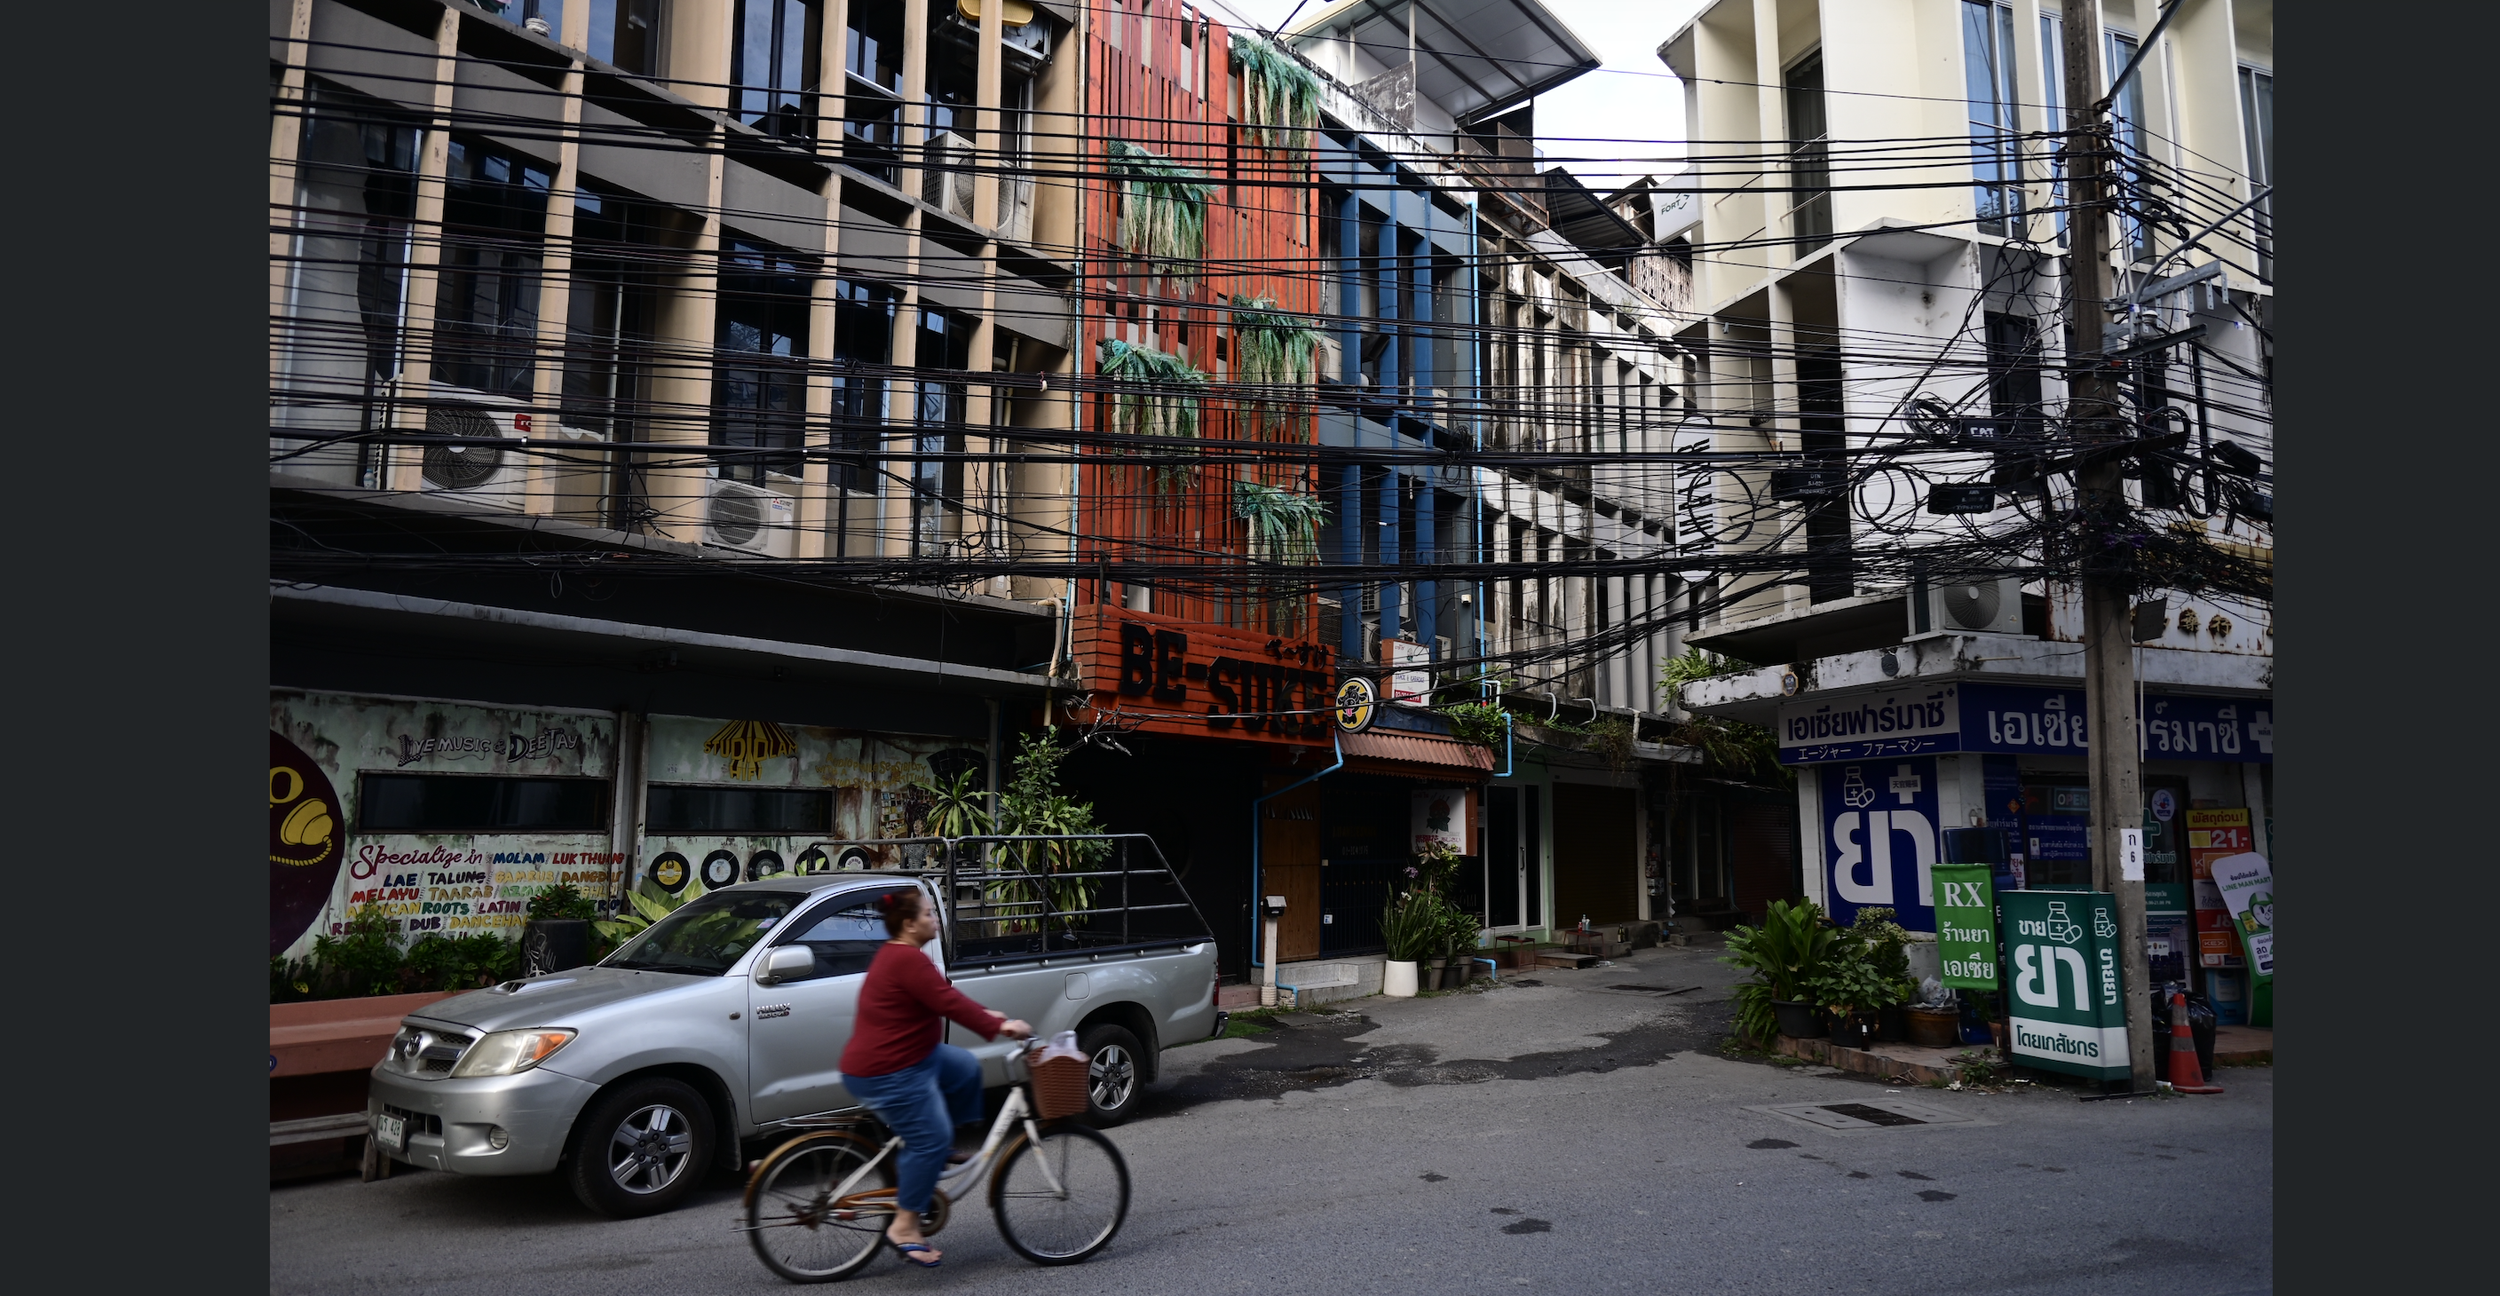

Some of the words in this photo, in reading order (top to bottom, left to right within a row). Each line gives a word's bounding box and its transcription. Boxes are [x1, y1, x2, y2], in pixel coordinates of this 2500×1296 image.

[1661, 199, 1681, 215] FORT
[1119, 622, 1328, 739] BE-SUKE
[1986, 694, 2241, 755] เอเซียาร์มาซี
[437, 737, 491, 753] MUSIC
[1797, 743, 1851, 761] エージャー
[1862, 737, 1936, 757] ファーマシー
[2057, 792, 2088, 806] OPEN
[2192, 811, 2243, 826] พัสดุด่วน!
[2128, 834, 2136, 846] ก
[351, 845, 463, 880] Specialize
[464, 851, 483, 864] in
[492, 852, 545, 864] MOLAM
[552, 853, 578, 864] LUK
[1832, 809, 1937, 907] ยา
[2130, 851, 2136, 863] 6
[383, 873, 418, 887] LAE
[427, 871, 486, 885] TALUNG
[2221, 882, 2238, 892] LINE
[2238, 880, 2255, 889] MAN
[2254, 876, 2272, 886] MART
[350, 888, 420, 903] MELAYU
[428, 886, 494, 900] TAARAB
[1941, 881, 1987, 908] RX
[421, 902, 470, 915] ROOTS
[477, 901, 521, 914] LATIN
[409, 917, 441, 931] DUB
[2018, 919, 2047, 937] ขาย
[2211, 914, 2233, 928] J&
[1942, 921, 1990, 943] ร้านยา
[1943, 952, 1995, 980] เอเซีย
[2014, 943, 2091, 1012] ยา
[2099, 947, 2117, 1006] ขายยา
[756, 1002, 791, 1015] HILUX
[2016, 1024, 2099, 1058] โดยเภสัชกร
